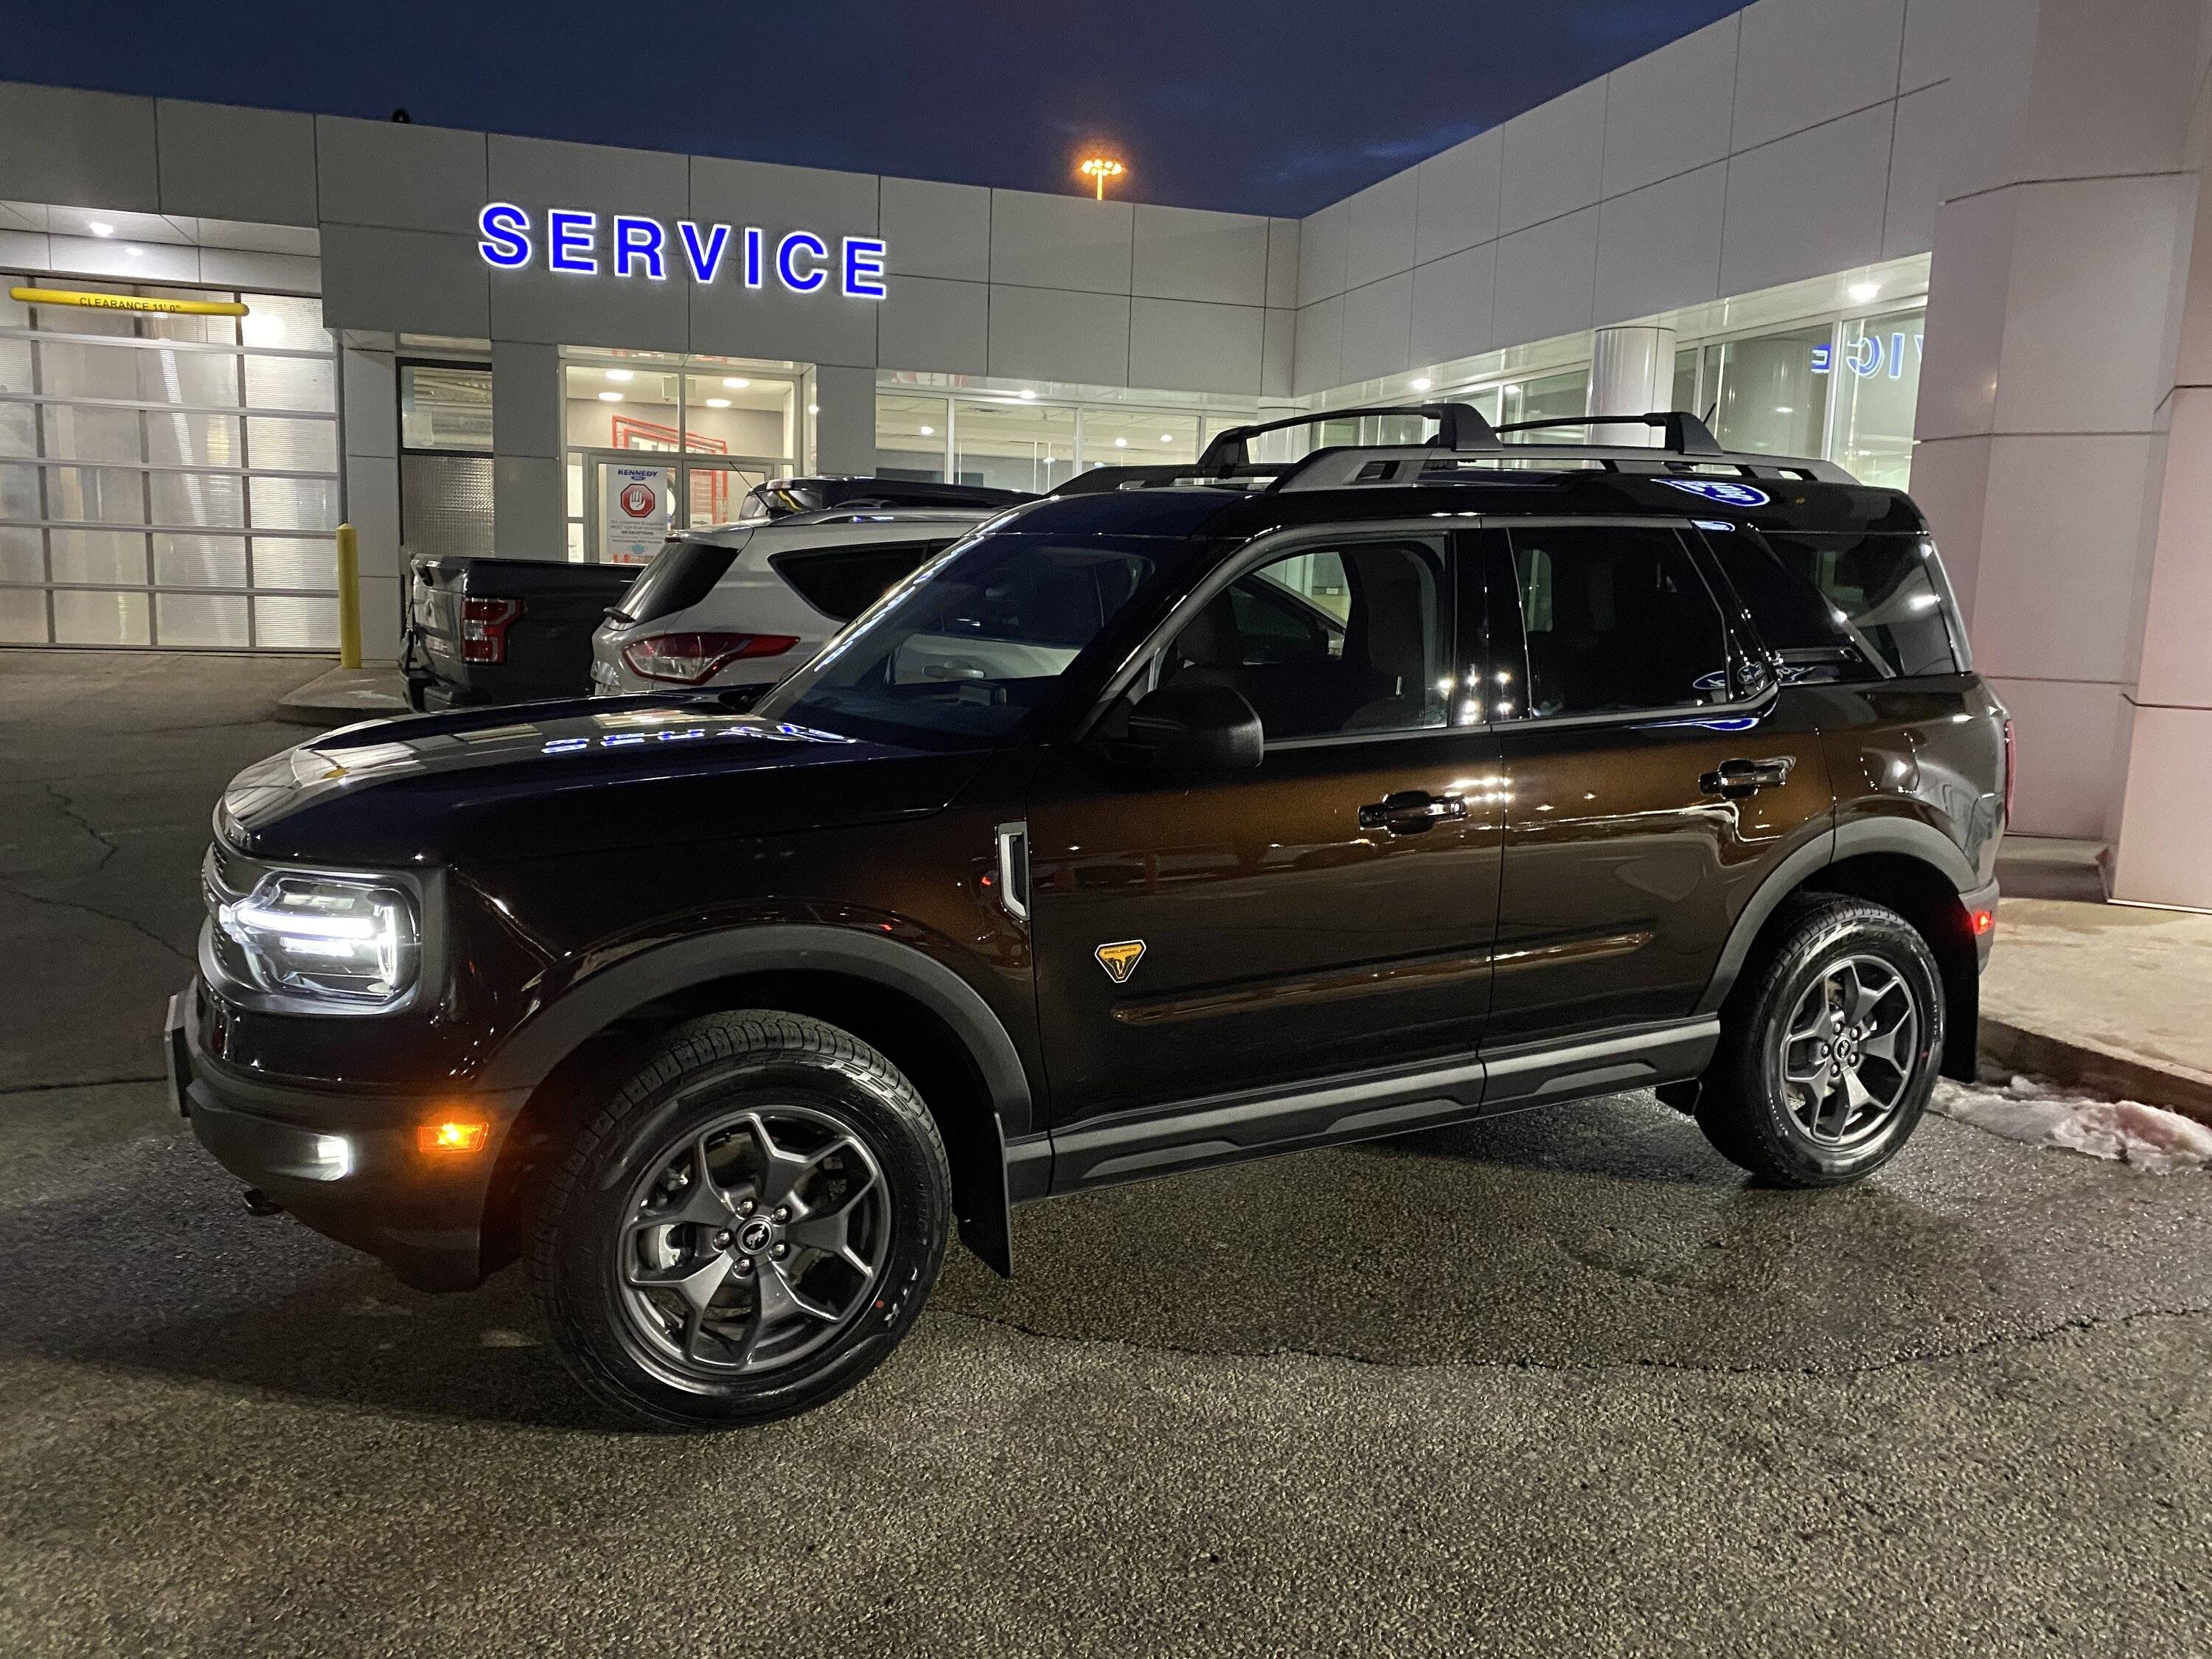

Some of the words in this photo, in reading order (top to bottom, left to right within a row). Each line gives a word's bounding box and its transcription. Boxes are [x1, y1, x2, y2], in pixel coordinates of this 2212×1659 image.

[479, 202, 887, 300] SERVICE
[79, 297, 149, 310] CLEARANCE
[617, 469, 658, 477] KENNEDY
[1104, 947, 1138, 955] BADLANDS
